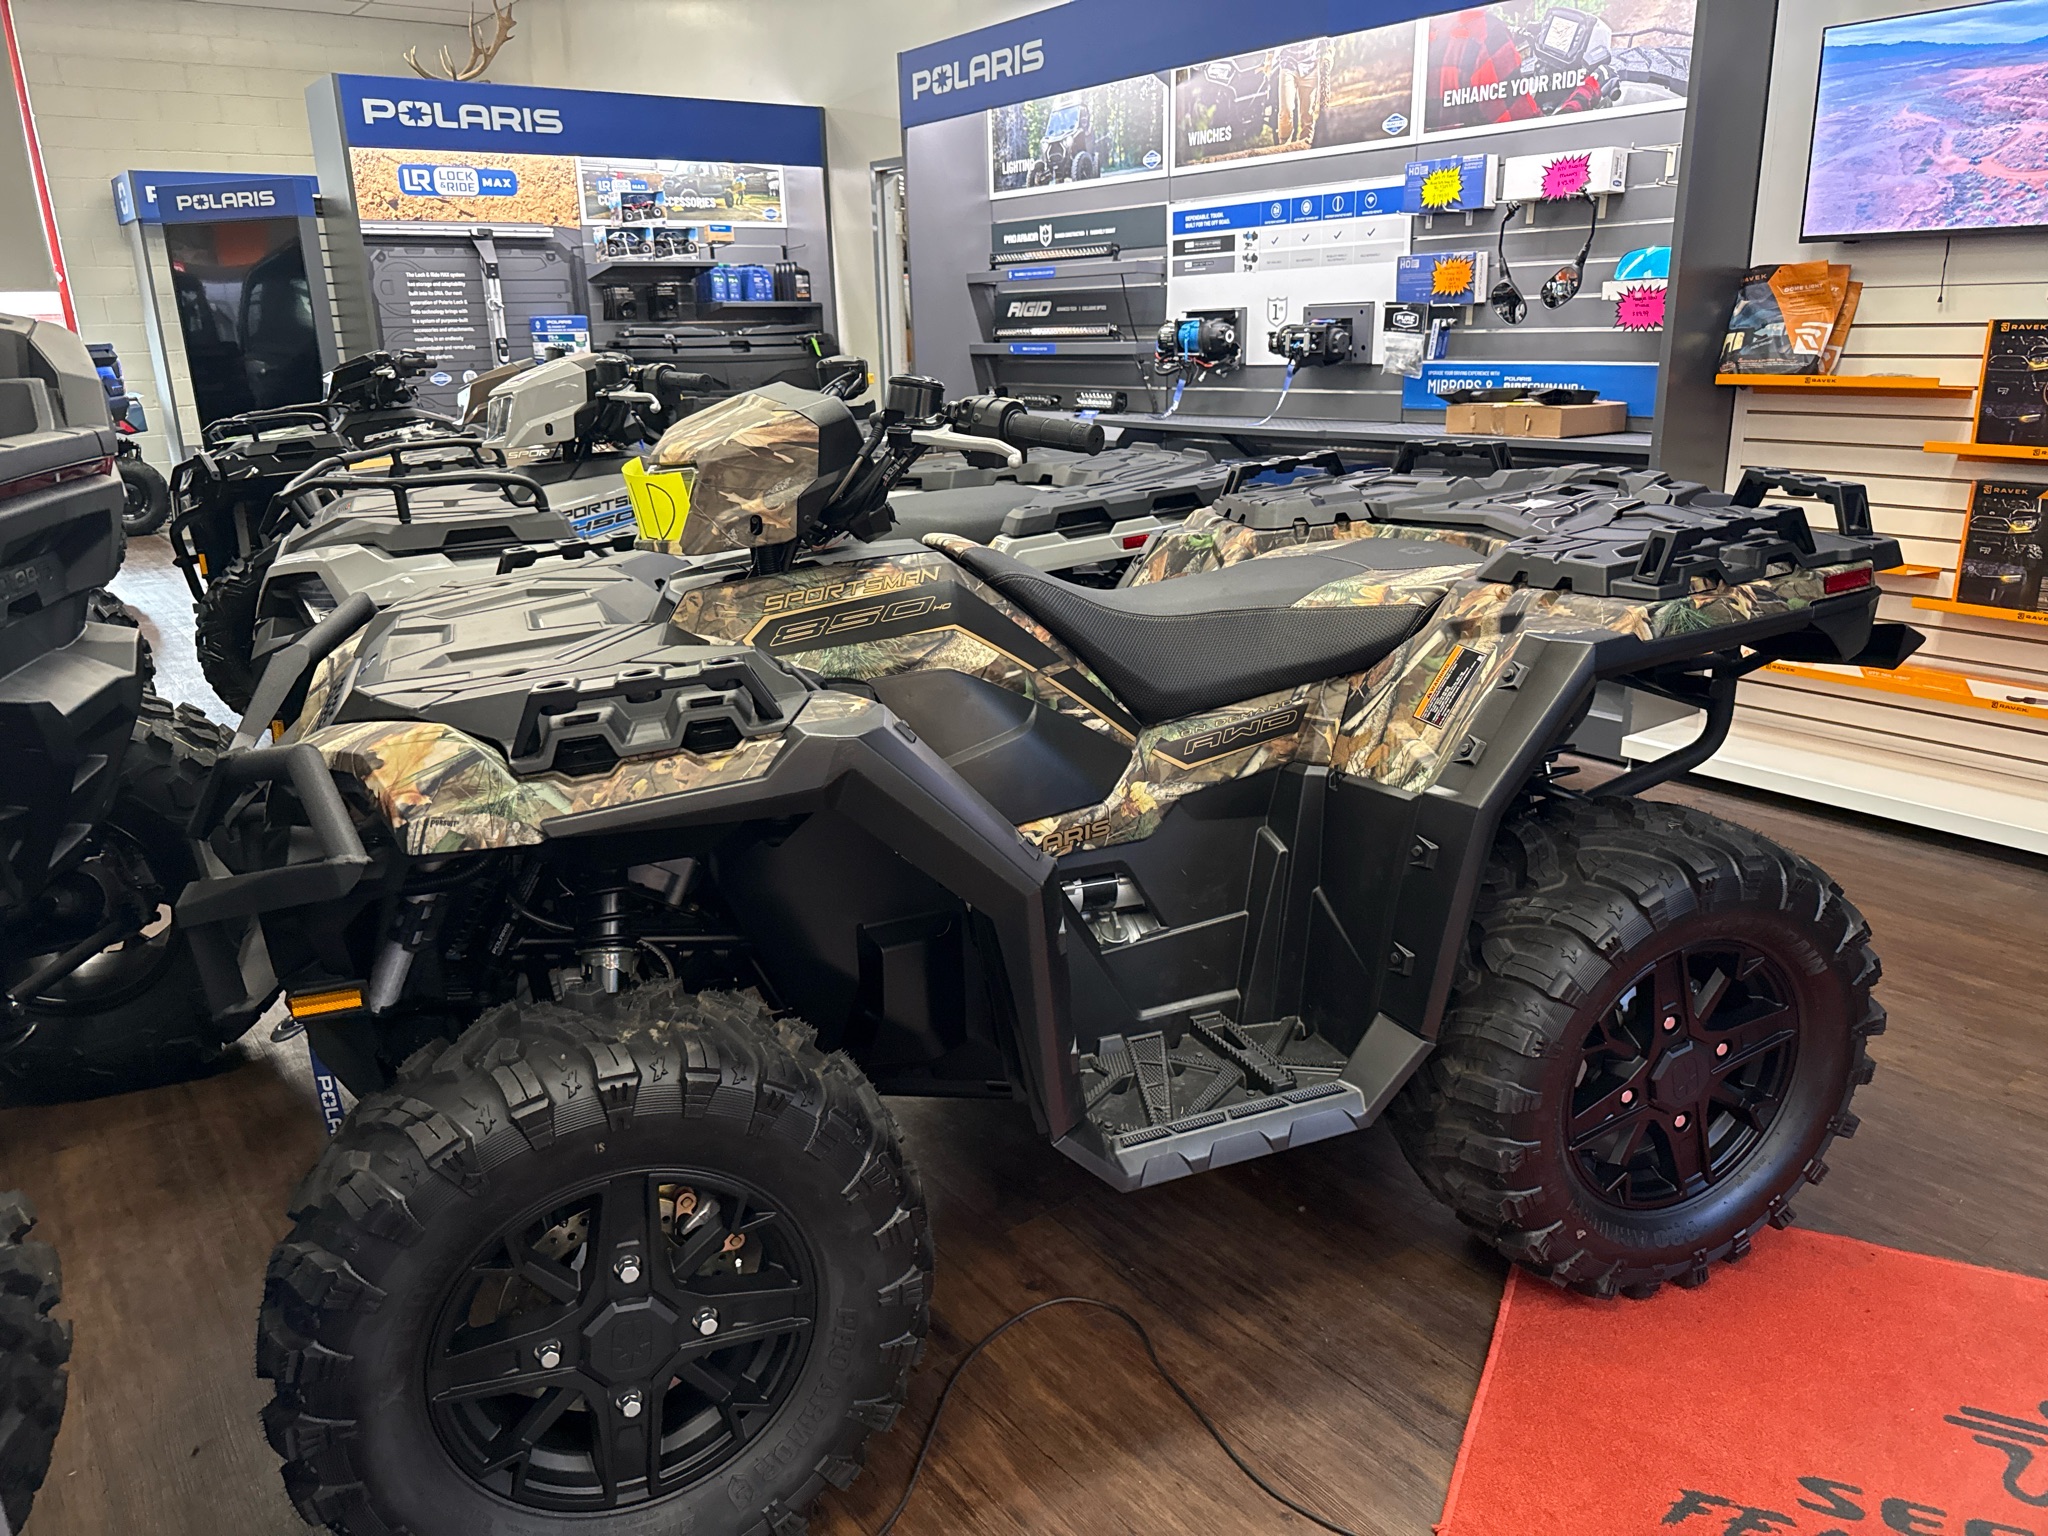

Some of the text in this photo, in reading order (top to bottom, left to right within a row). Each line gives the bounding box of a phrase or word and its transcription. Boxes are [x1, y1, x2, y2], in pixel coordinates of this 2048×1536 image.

[912, 38, 1044, 101] POLARIS
[1443, 67, 1587, 107] ENHANCE YOUR RIDE
[362, 98, 564, 134] POLARIS
[1188, 125, 1232, 147] WINCHES
[1002, 158, 1036, 175] LIGHTING
[402, 168, 434, 192] LR
[438, 170, 512, 188] LOCK MAX
[598, 180, 612, 192] LR
[175, 190, 276, 212] POLARIS
[1743, 273, 1768, 283] AVEK
[1783, 285, 1804, 293] DOME
[1007, 301, 1052, 317] RIGID
[1993, 487, 2029, 495] RAVEK
[763, 565, 942, 613] SPORTSMAN
[770, 595, 952, 647] 850 HO
[1431, 663, 1450, 694] WARNING
[1771, 664, 1796, 673] RAVEK
[1181, 699, 1293, 738] ON DEMAND
[1999, 703, 2029, 713] RAVEK
[1184, 709, 1299, 756] AWD
[1042, 819, 1111, 851] ARIS
[317, 1075, 343, 1135] POLA
[753, 1307, 859, 1481] PRO ARMOR
